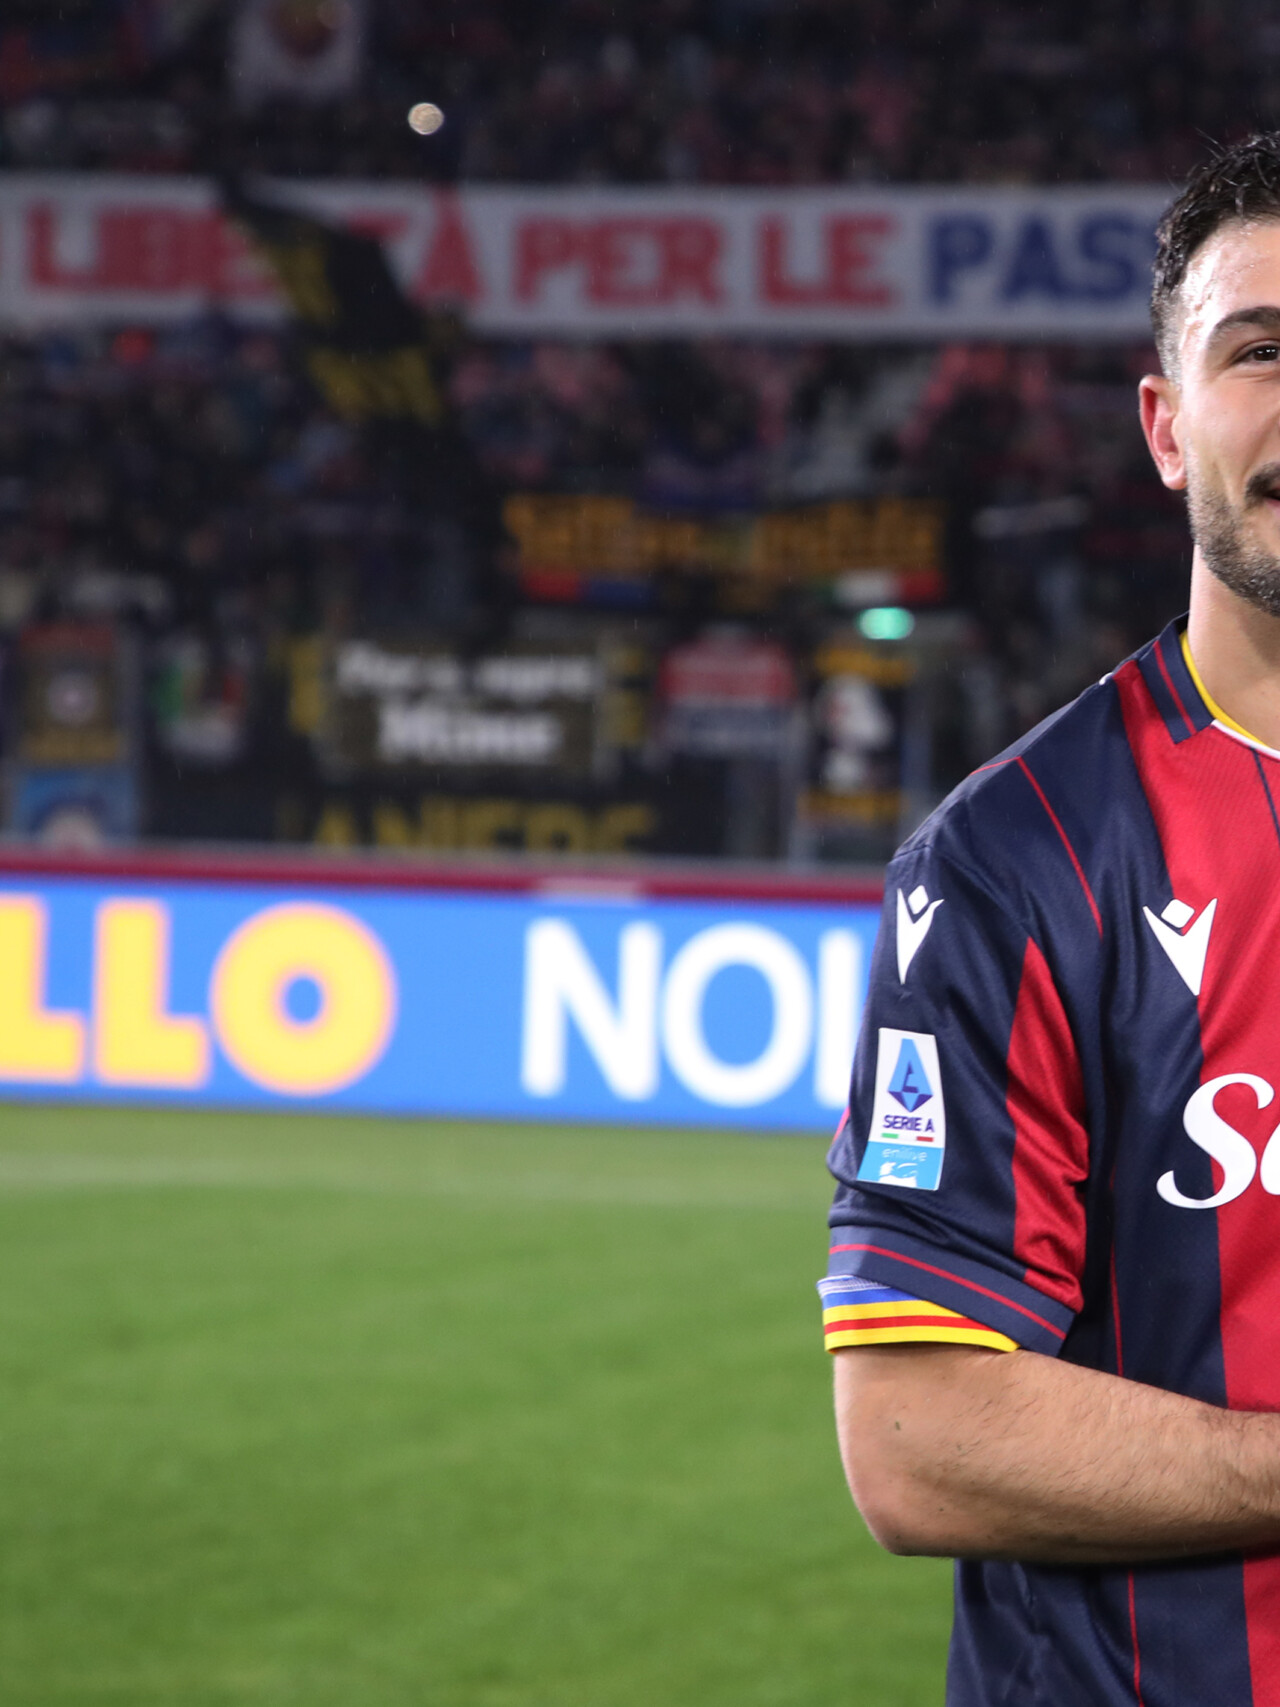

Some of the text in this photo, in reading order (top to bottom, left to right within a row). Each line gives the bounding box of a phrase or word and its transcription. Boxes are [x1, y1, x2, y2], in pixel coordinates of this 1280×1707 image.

[510, 214, 724, 307] PER
[758, 214, 895, 306] LE
[925, 210, 1160, 306] PAS
[0, 892, 397, 1098] LLO
[882, 1114, 935, 1133] SERIE A
